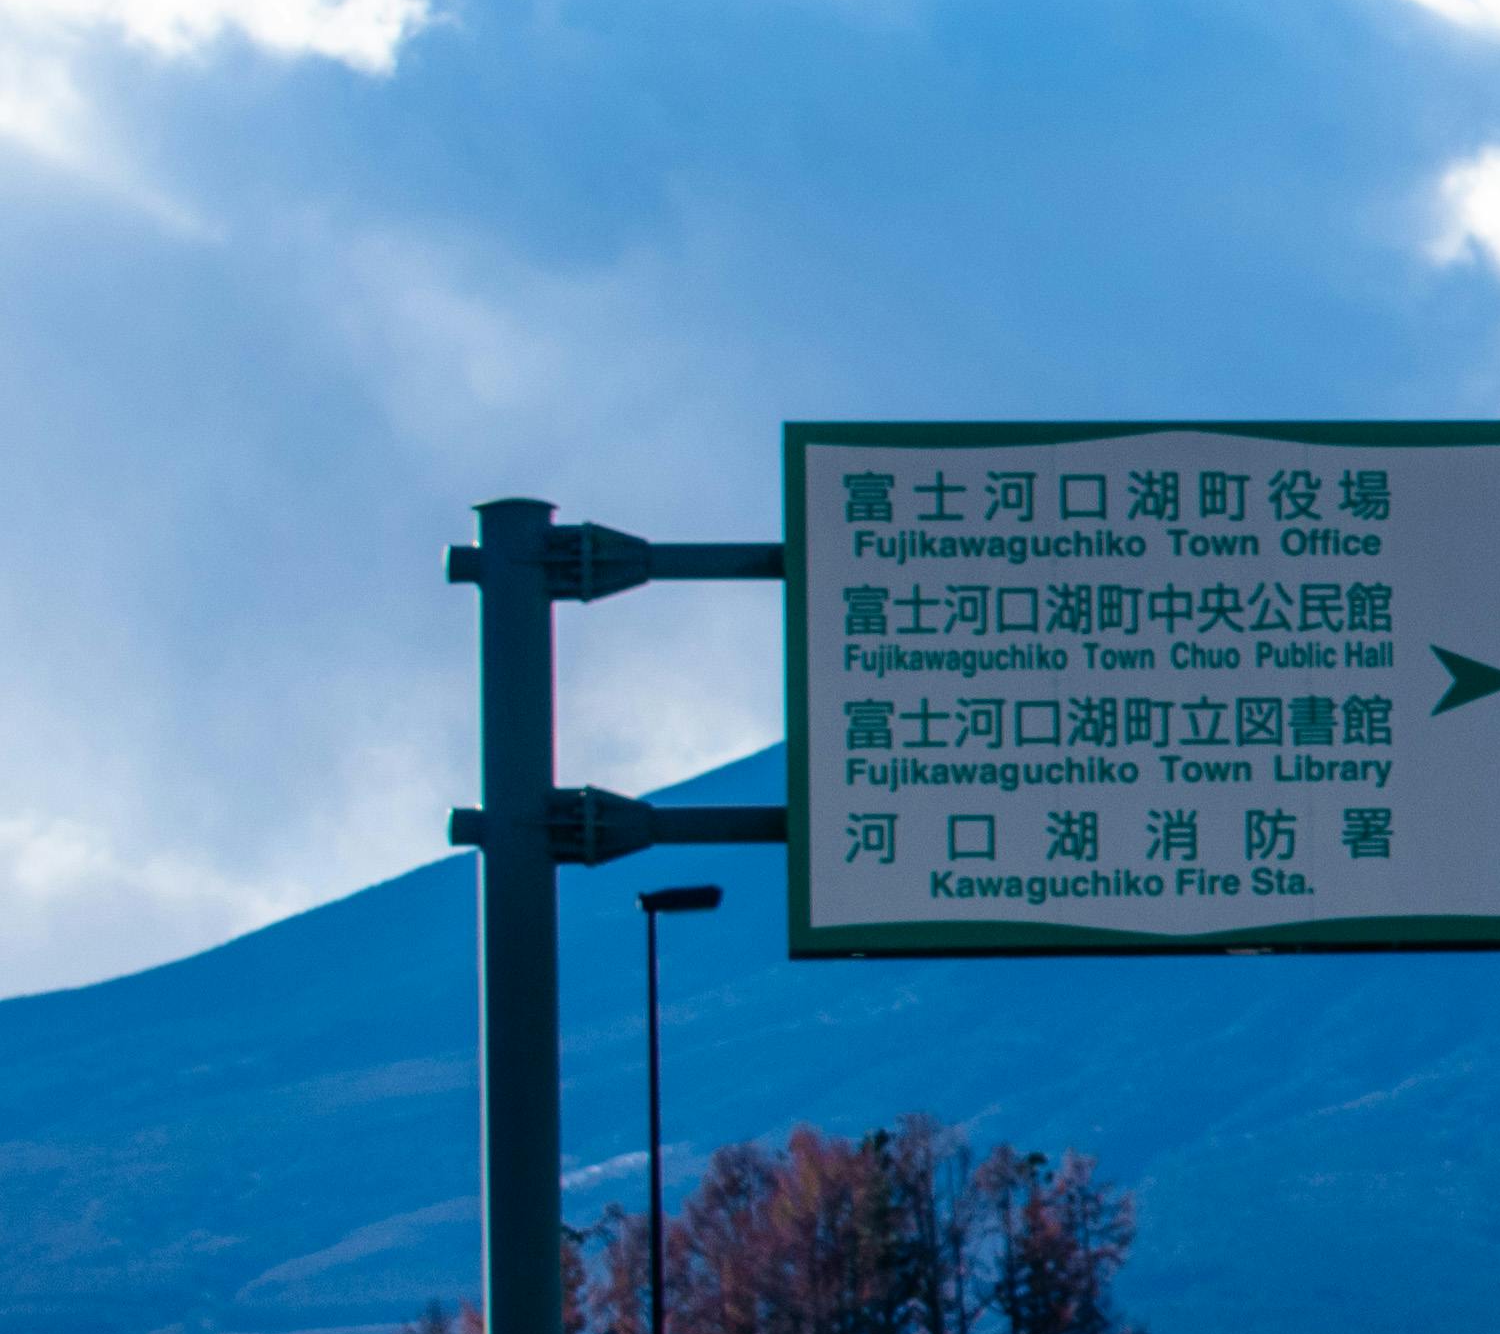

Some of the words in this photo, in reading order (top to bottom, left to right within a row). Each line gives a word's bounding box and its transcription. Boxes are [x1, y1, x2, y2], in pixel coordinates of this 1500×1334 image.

[841, 468, 1392, 524] 富士河口湖町役場
[852, 528, 1147, 566] Fujikawaguchiko
[1165, 527, 1260, 558] Town
[1279, 526, 1382, 558] Office
[842, 581, 1393, 637] 富士河口湖町中央公民館
[842, 641, 1068, 680] Fujikawaguchiko
[1081, 641, 1156, 671] Town
[1169, 640, 1241, 671] Chuo
[1254, 640, 1337, 670] Public
[1343, 639, 1394, 669] Hall
[842, 693, 1393, 751] 富士河口湖町立図書館
[845, 755, 1140, 794] Fujikawaguchiko
[1158, 754, 1253, 784] Town
[1272, 753, 1393, 789] Library
[844, 807, 1394, 865] 河口湖消防署
[929, 868, 1165, 906] Kawaguchiko
[1174, 867, 1241, 897] Fire
[1250, 865, 1315, 897] Sta.
